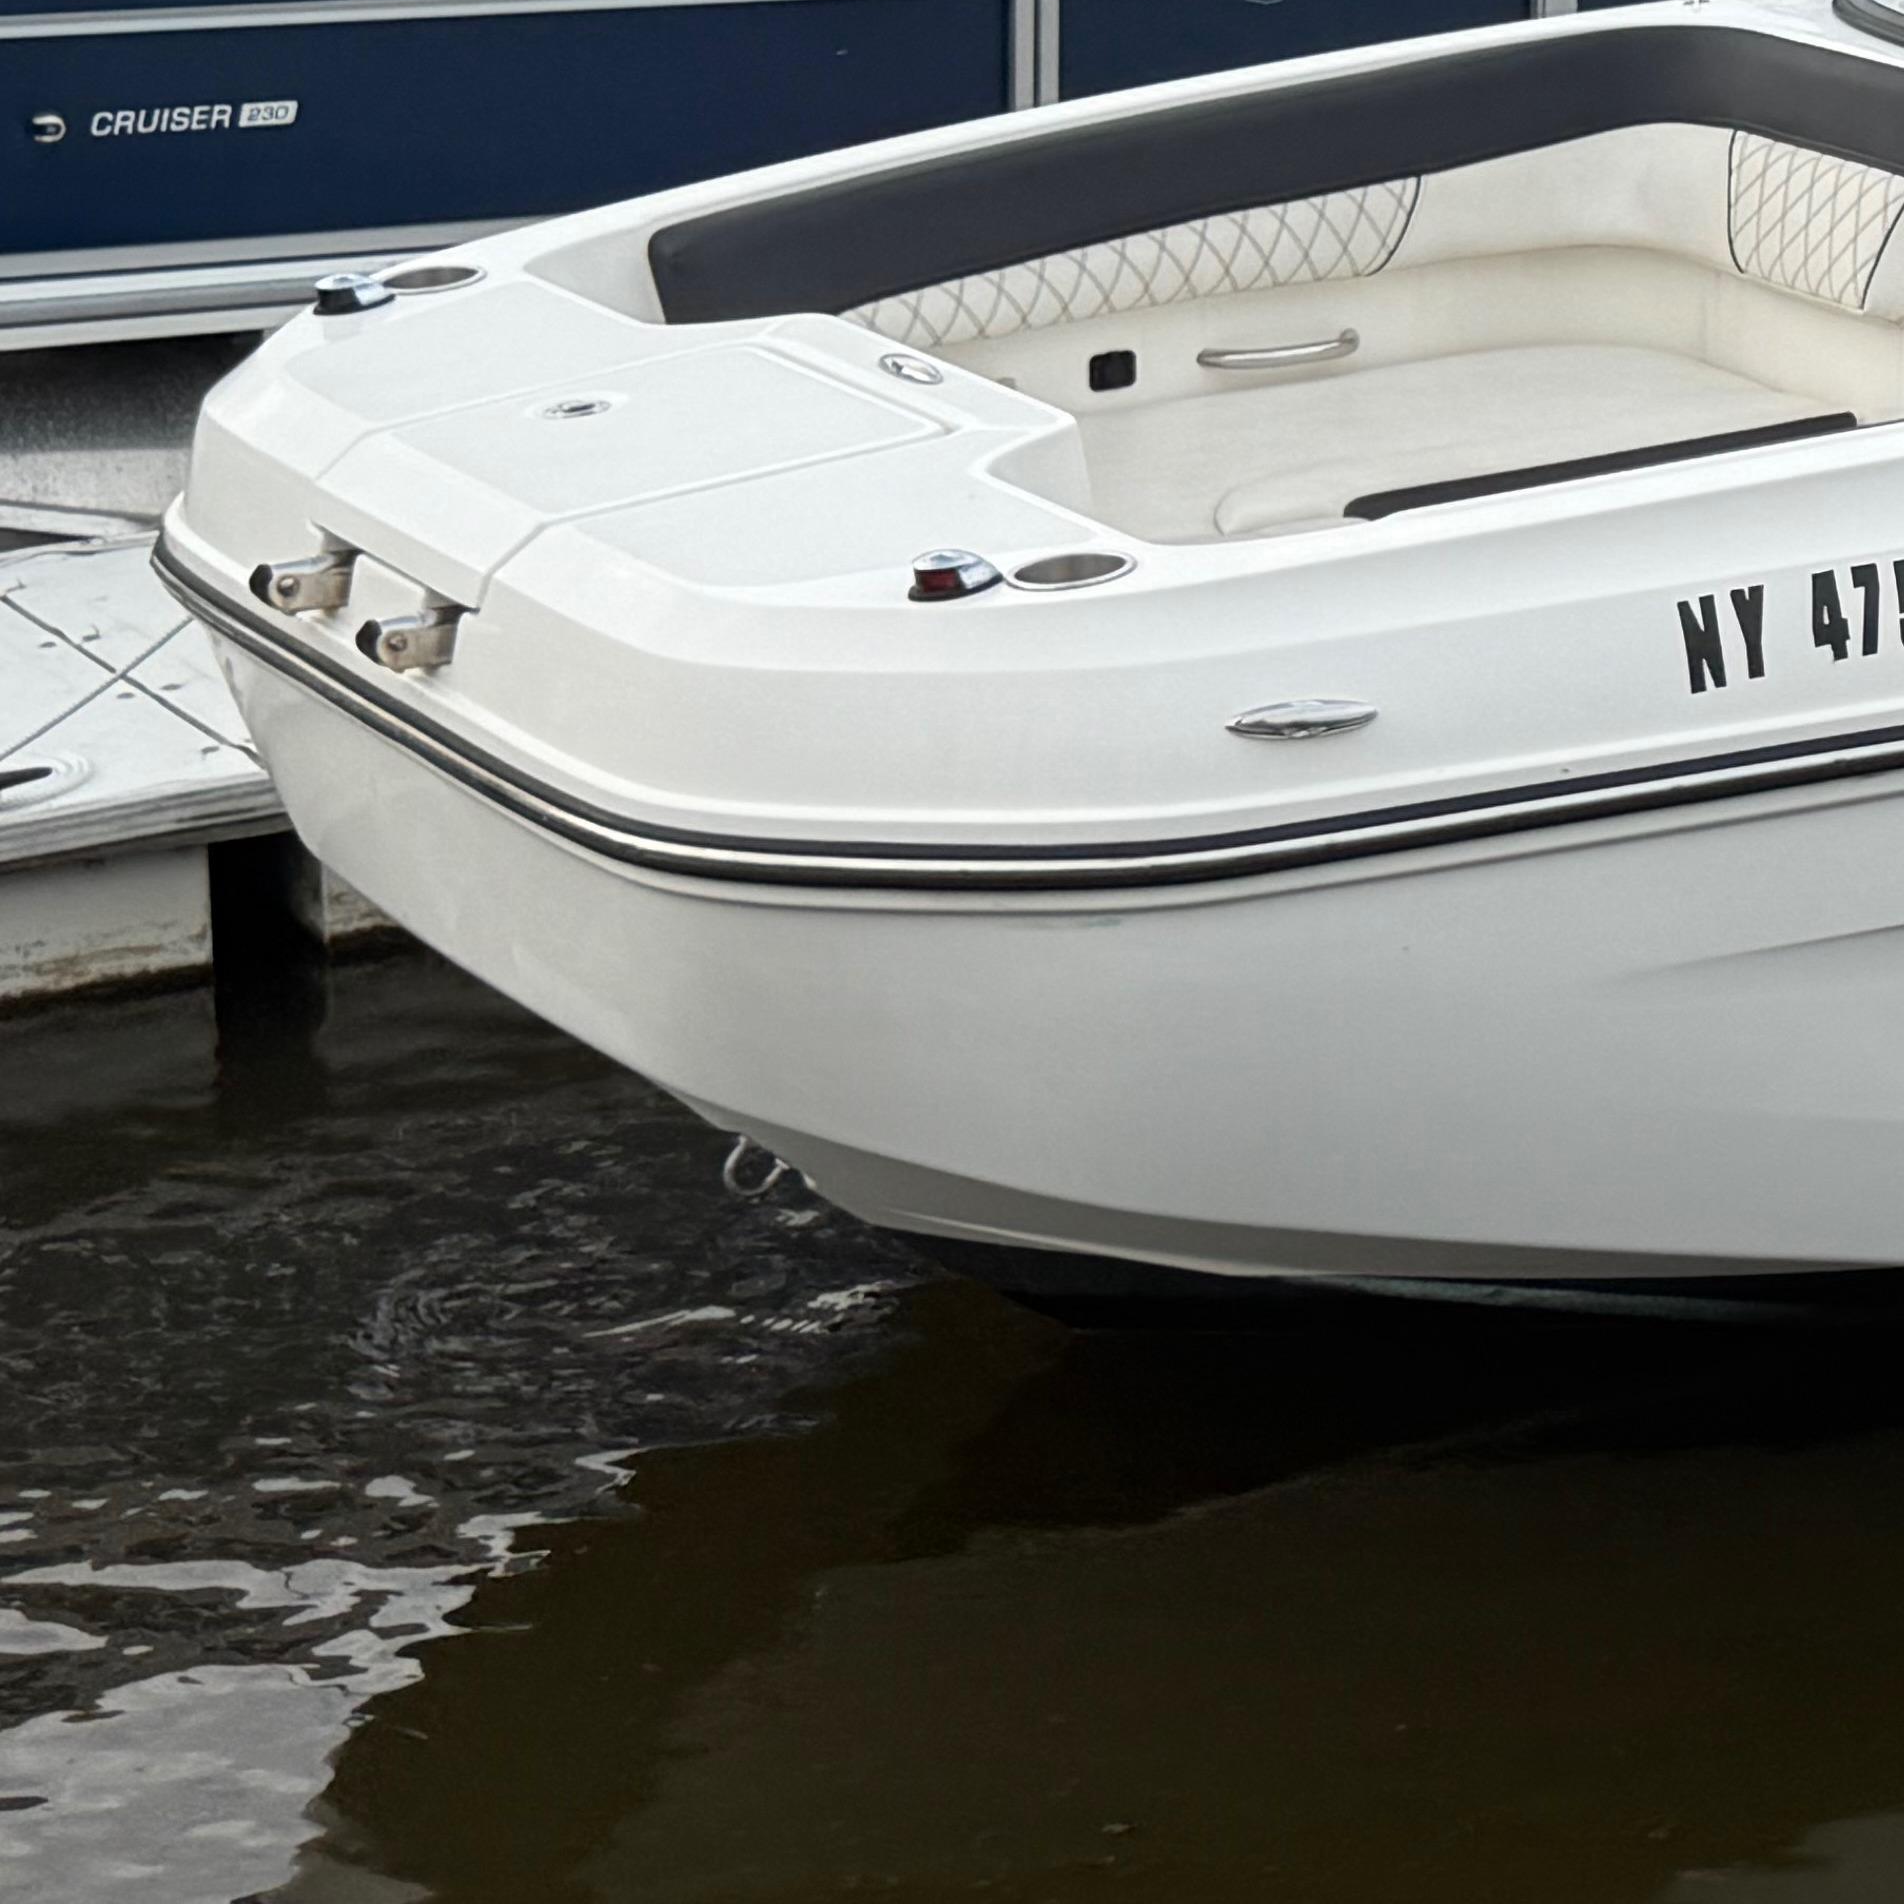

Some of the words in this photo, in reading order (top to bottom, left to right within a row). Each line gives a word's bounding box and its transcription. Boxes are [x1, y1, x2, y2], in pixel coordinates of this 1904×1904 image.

[90, 103, 233, 137] CRUISER
[246, 104, 290, 122] 230
[1676, 584, 1765, 694] NY
